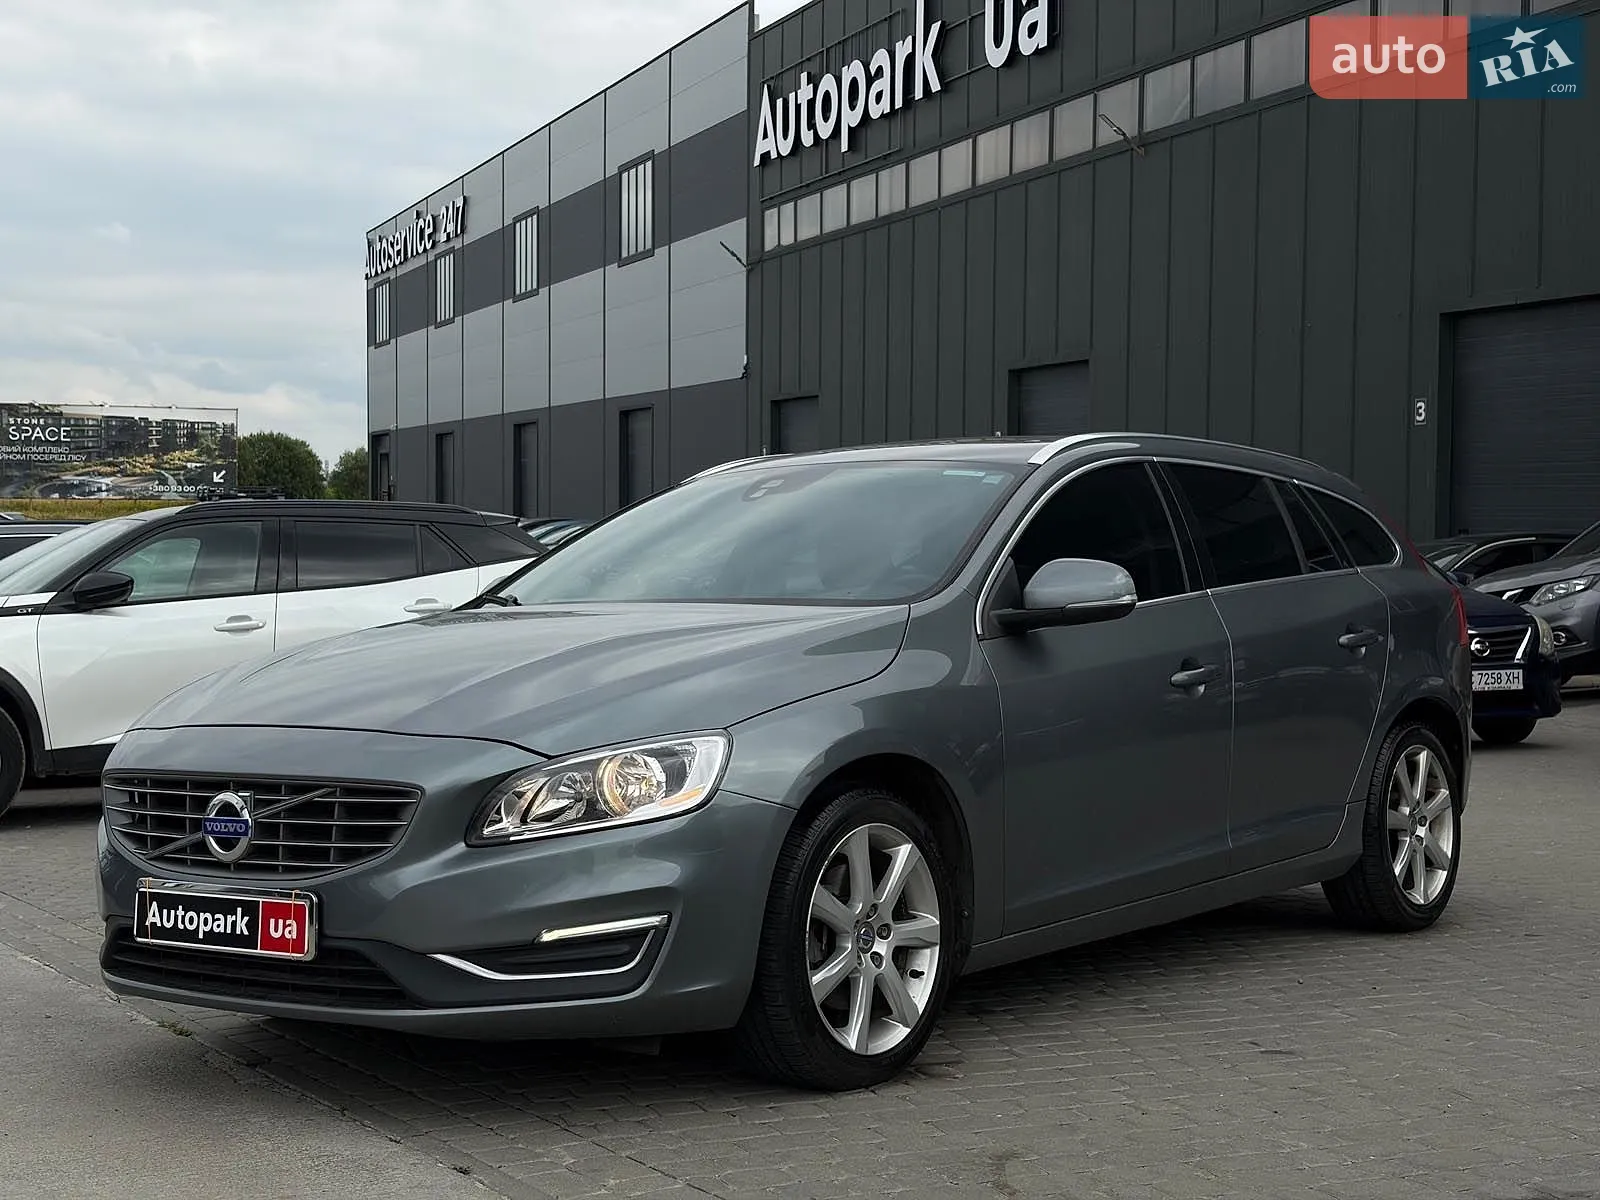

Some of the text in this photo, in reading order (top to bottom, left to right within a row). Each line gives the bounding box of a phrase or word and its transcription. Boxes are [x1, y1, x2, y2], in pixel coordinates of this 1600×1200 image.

[753, 0, 942, 167] Autopark
[1416, 402, 1426, 421] 3
[8, 417, 45, 425] STONE
[9, 426, 71, 441] SPACE
[1477, 672, 1503, 686] 7258
[205, 821, 246, 833] VOLVO
[145, 901, 297, 939] Autopark ua
